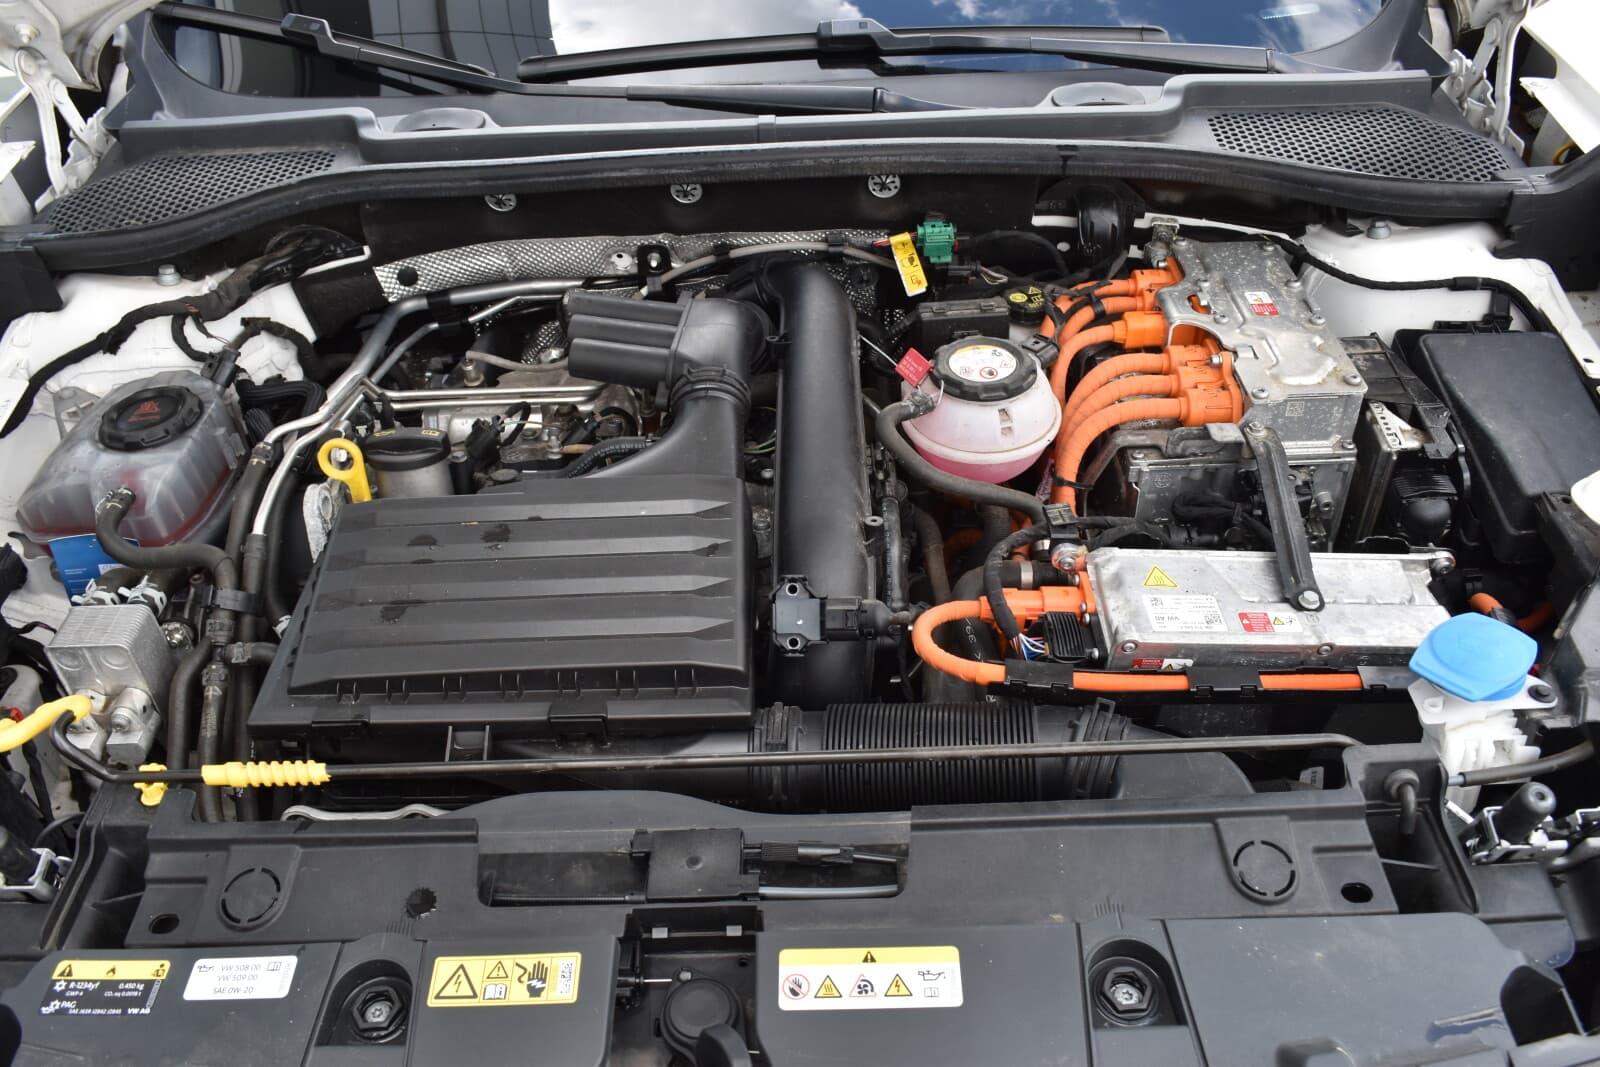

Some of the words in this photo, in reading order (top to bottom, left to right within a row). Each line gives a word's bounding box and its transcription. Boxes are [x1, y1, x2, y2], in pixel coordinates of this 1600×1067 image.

[221, 964, 234, 972] VW
[234, 963, 250, 971] 508
[217, 974, 231, 982] VW
[232, 973, 247, 981] 509
[69, 981, 100, 991] R-1234yf
[213, 986, 227, 994] SAE
[228, 986, 254, 994] 0W-20
[61, 1000, 77, 1008] PAG
